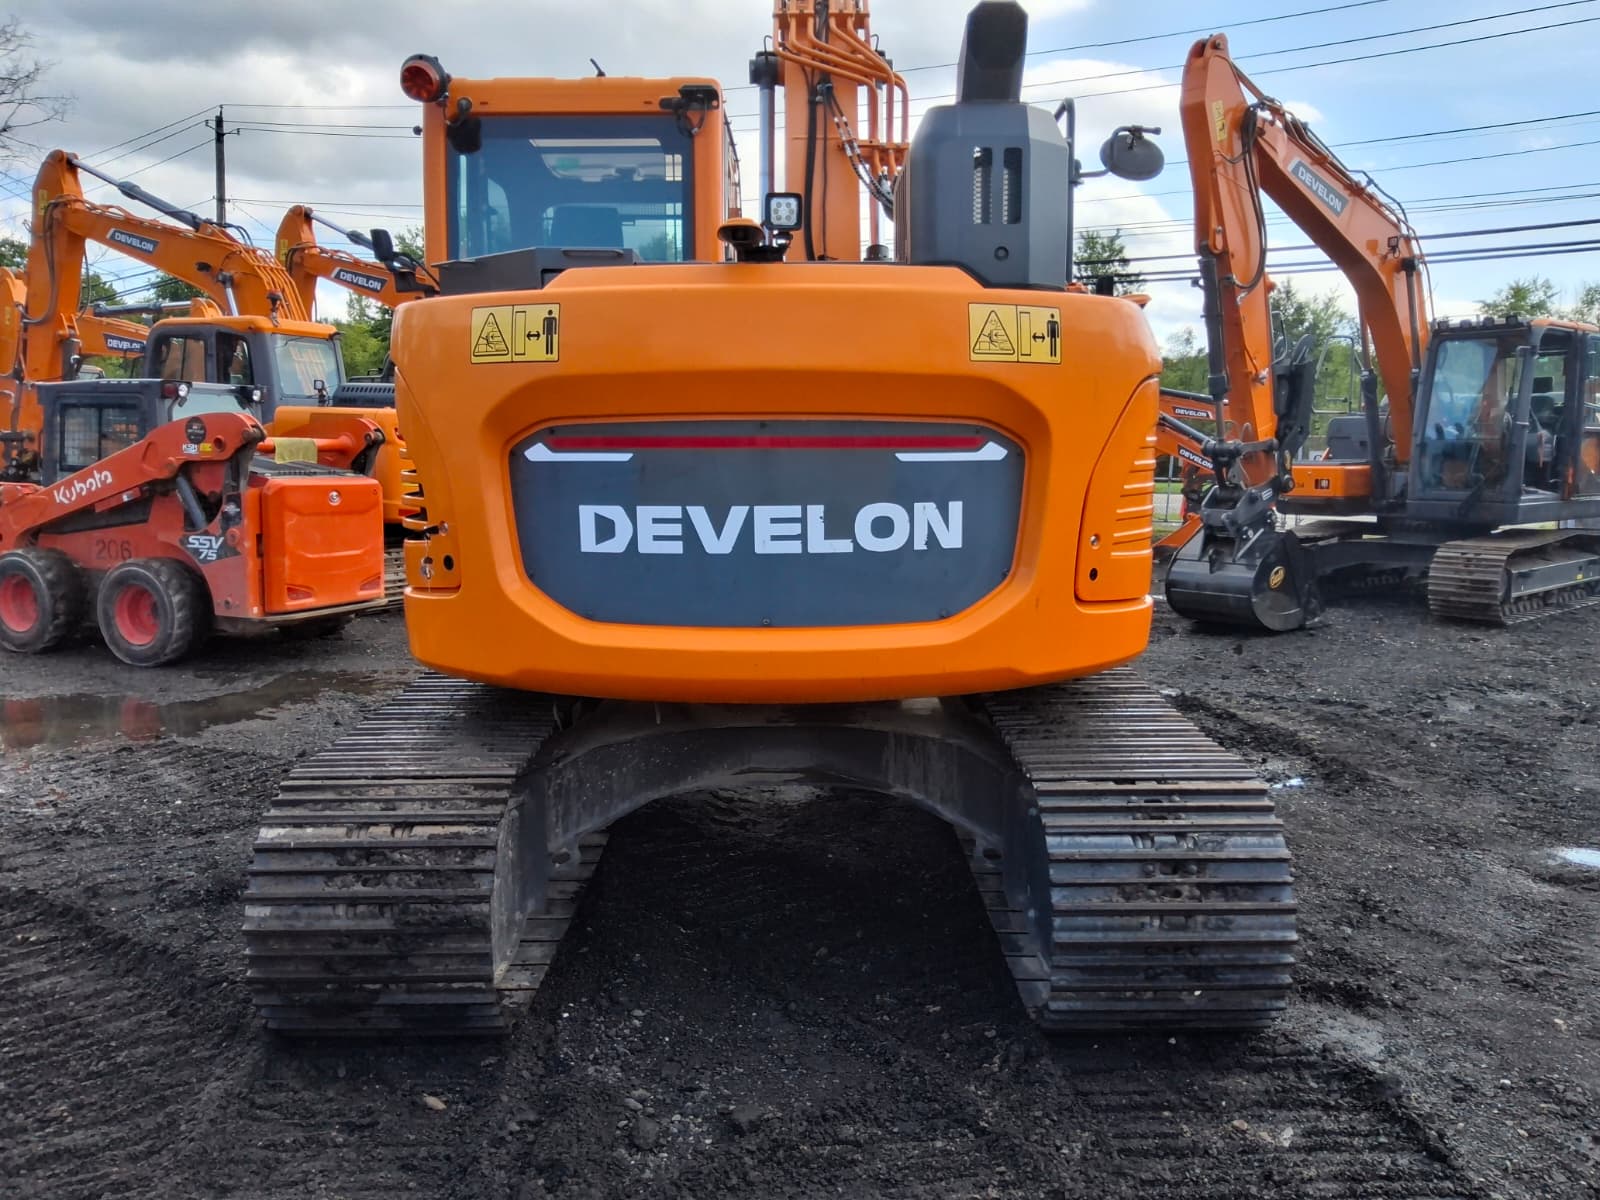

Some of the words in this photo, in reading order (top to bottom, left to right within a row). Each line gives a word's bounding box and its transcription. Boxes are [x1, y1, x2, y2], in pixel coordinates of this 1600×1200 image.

[1298, 166, 1342, 212] DEVELON
[115, 231, 154, 251] DEVELON
[340, 271, 382, 290] DEVELON
[53, 469, 113, 505] Kubota
[578, 500, 964, 555] DEVELON
[96, 539, 132, 561] 206
[187, 534, 225, 549] SSV
[198, 549, 217, 561] 75
